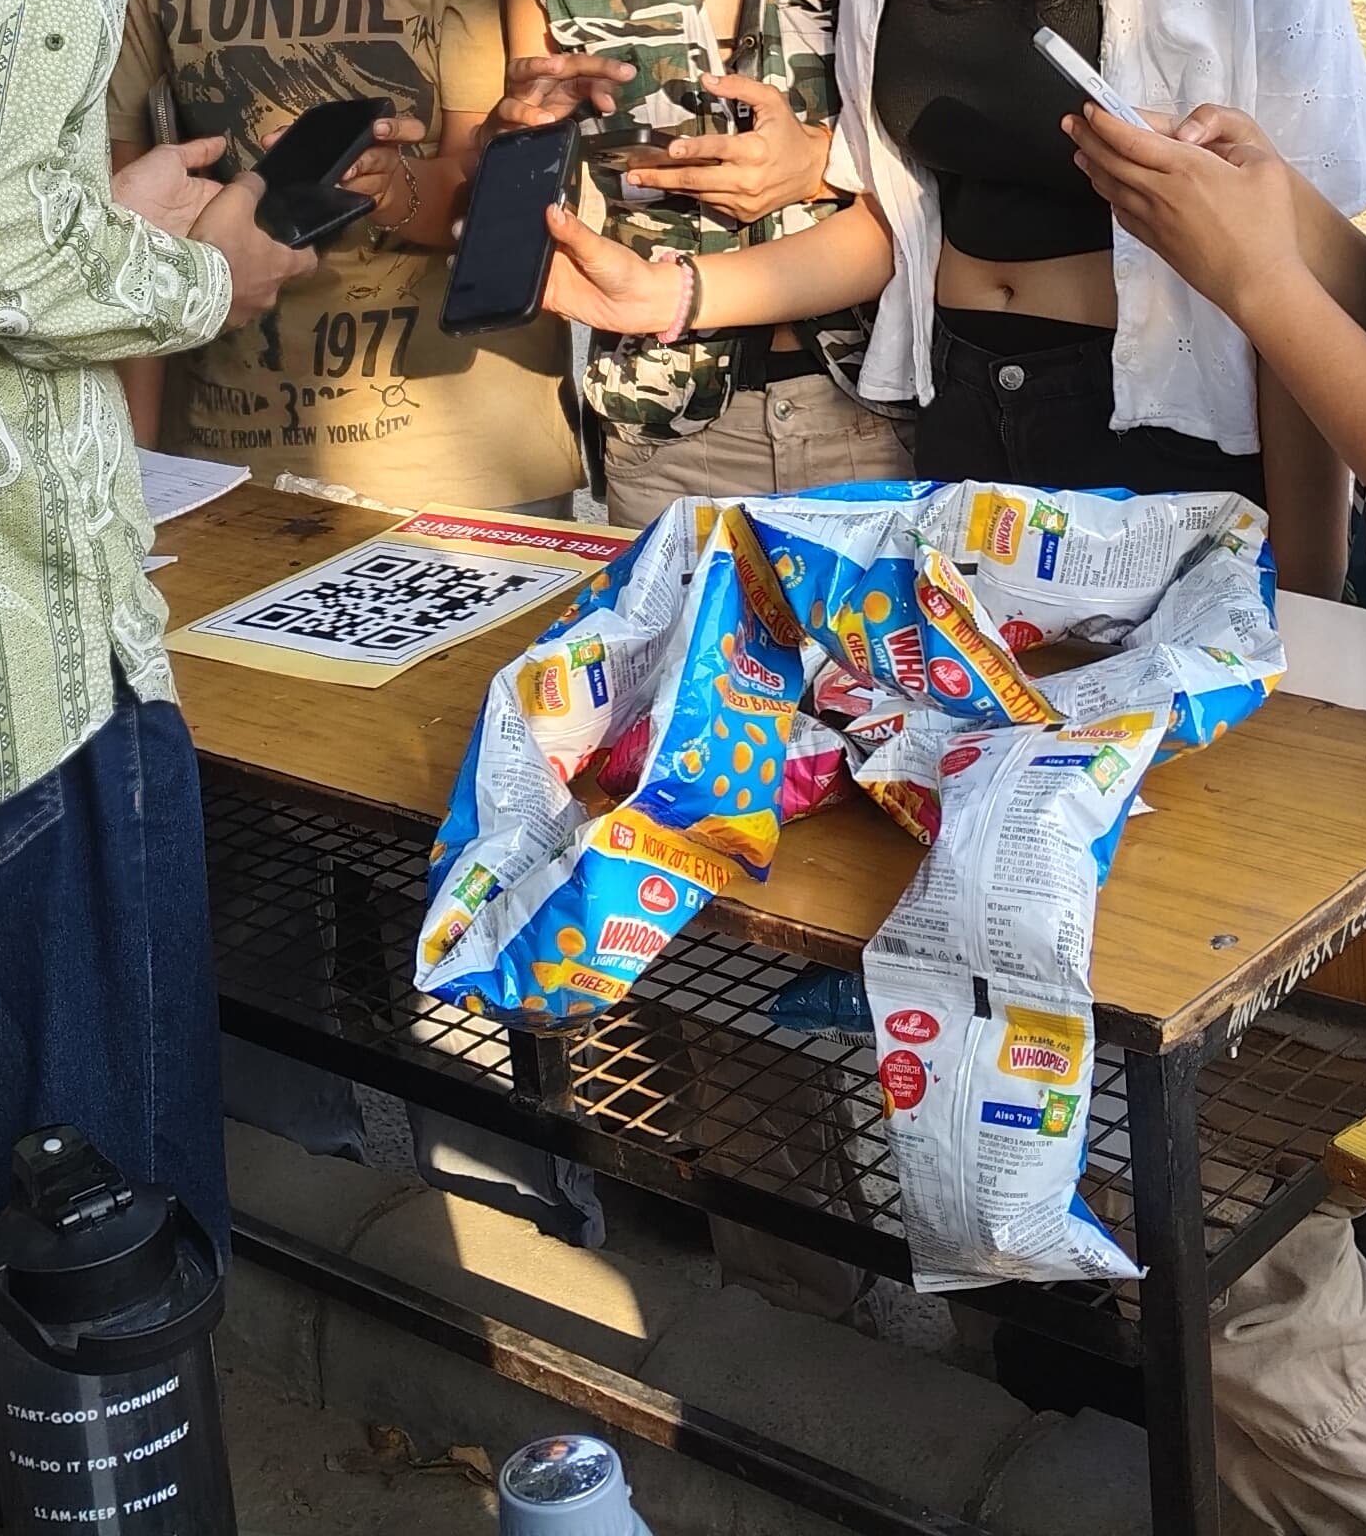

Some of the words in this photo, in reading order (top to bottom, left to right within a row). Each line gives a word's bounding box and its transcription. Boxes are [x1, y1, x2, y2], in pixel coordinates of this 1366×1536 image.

[313, 306, 420, 378] 1977
[231, 427, 272, 449] FROM
[282, 426, 317, 447] NEW
[327, 422, 370, 444] YORK
[409, 520, 565, 548] REFRESHMENTS
[995, 508, 1017, 555] WHOOPIES
[1045, 540, 1056, 553] Try
[562, 539, 618, 556] FREE
[1044, 554, 1052, 570] Also
[871, 638, 890, 672] LIGHT
[951, 618, 986, 654] NOW
[979, 652, 1008, 686] 20%
[544, 668, 564, 711] WHOOPIES
[750, 695, 792, 714] BALLS
[643, 834, 666, 861] NOW
[668, 848, 690, 873] 20%
[600, 921, 668, 957] WHOOP
[591, 956, 618, 967] LIGHT
[571, 972, 614, 994] CHEEZI
[1011, 1047, 1069, 1074] WHOOPIES
[995, 1109, 1014, 1121] Also
[1017, 1112, 1033, 1125] Try
[6, 1403, 99, 1424] START-GOOD
[106, 1375, 180, 1419] MORNING!
[67, 1461, 81, 1473] IT
[87, 1456, 118, 1472] FOR
[123, 1421, 190, 1465] YOURSELF
[123, 1483, 179, 1515] TRYING
